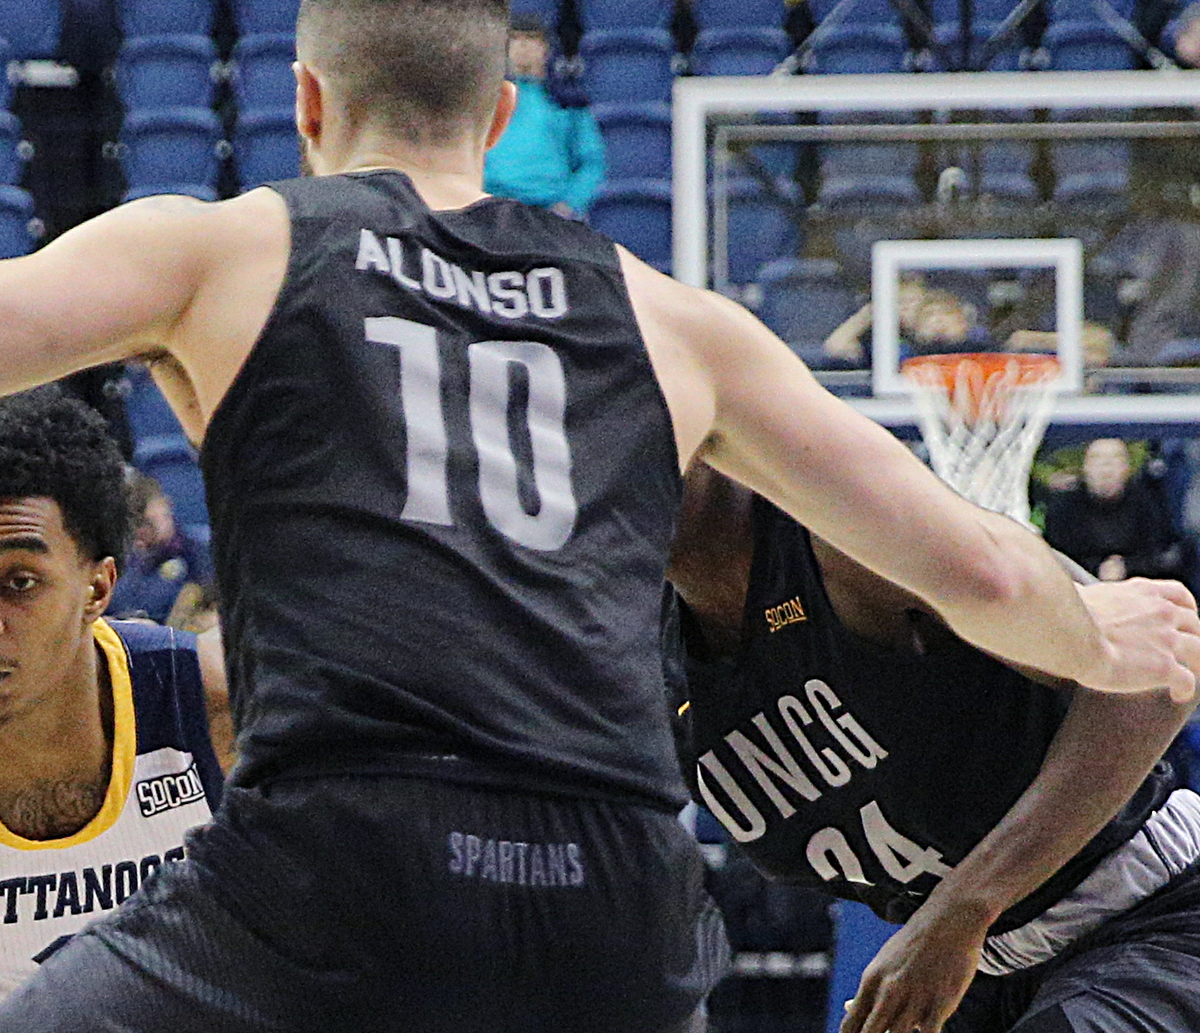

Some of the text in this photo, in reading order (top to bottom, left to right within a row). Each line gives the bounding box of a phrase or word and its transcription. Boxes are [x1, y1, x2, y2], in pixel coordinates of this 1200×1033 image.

[355, 227, 568, 319] ALONSO
[364, 315, 578, 551] 10
[696, 678, 889, 843] UNCG
[450, 831, 584, 887] SPARTANS
[806, 800, 954, 887] 24
